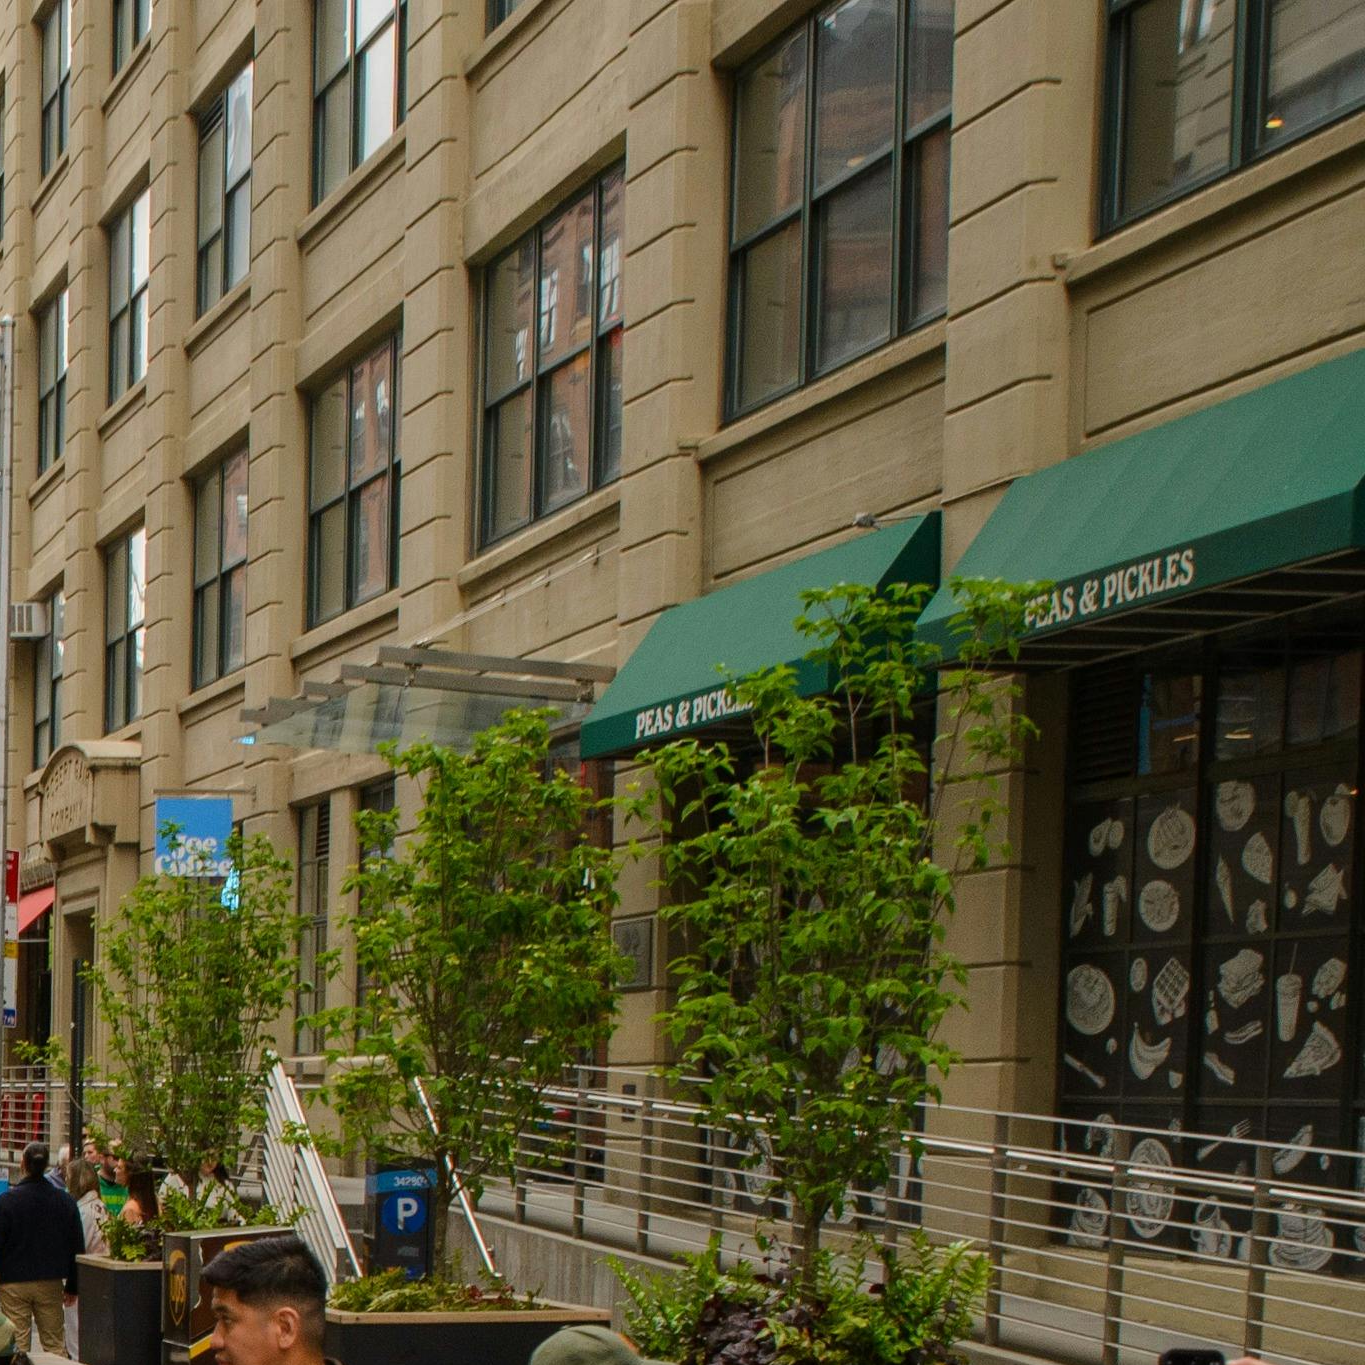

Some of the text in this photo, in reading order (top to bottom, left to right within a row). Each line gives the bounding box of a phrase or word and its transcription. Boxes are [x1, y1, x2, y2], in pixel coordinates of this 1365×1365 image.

[1079, 579, 1099, 616] &
[1102, 549, 1195, 609] PICKLES
[635, 682, 754, 739] PEAS & PICKL
[397, 1197, 418, 1230] P
